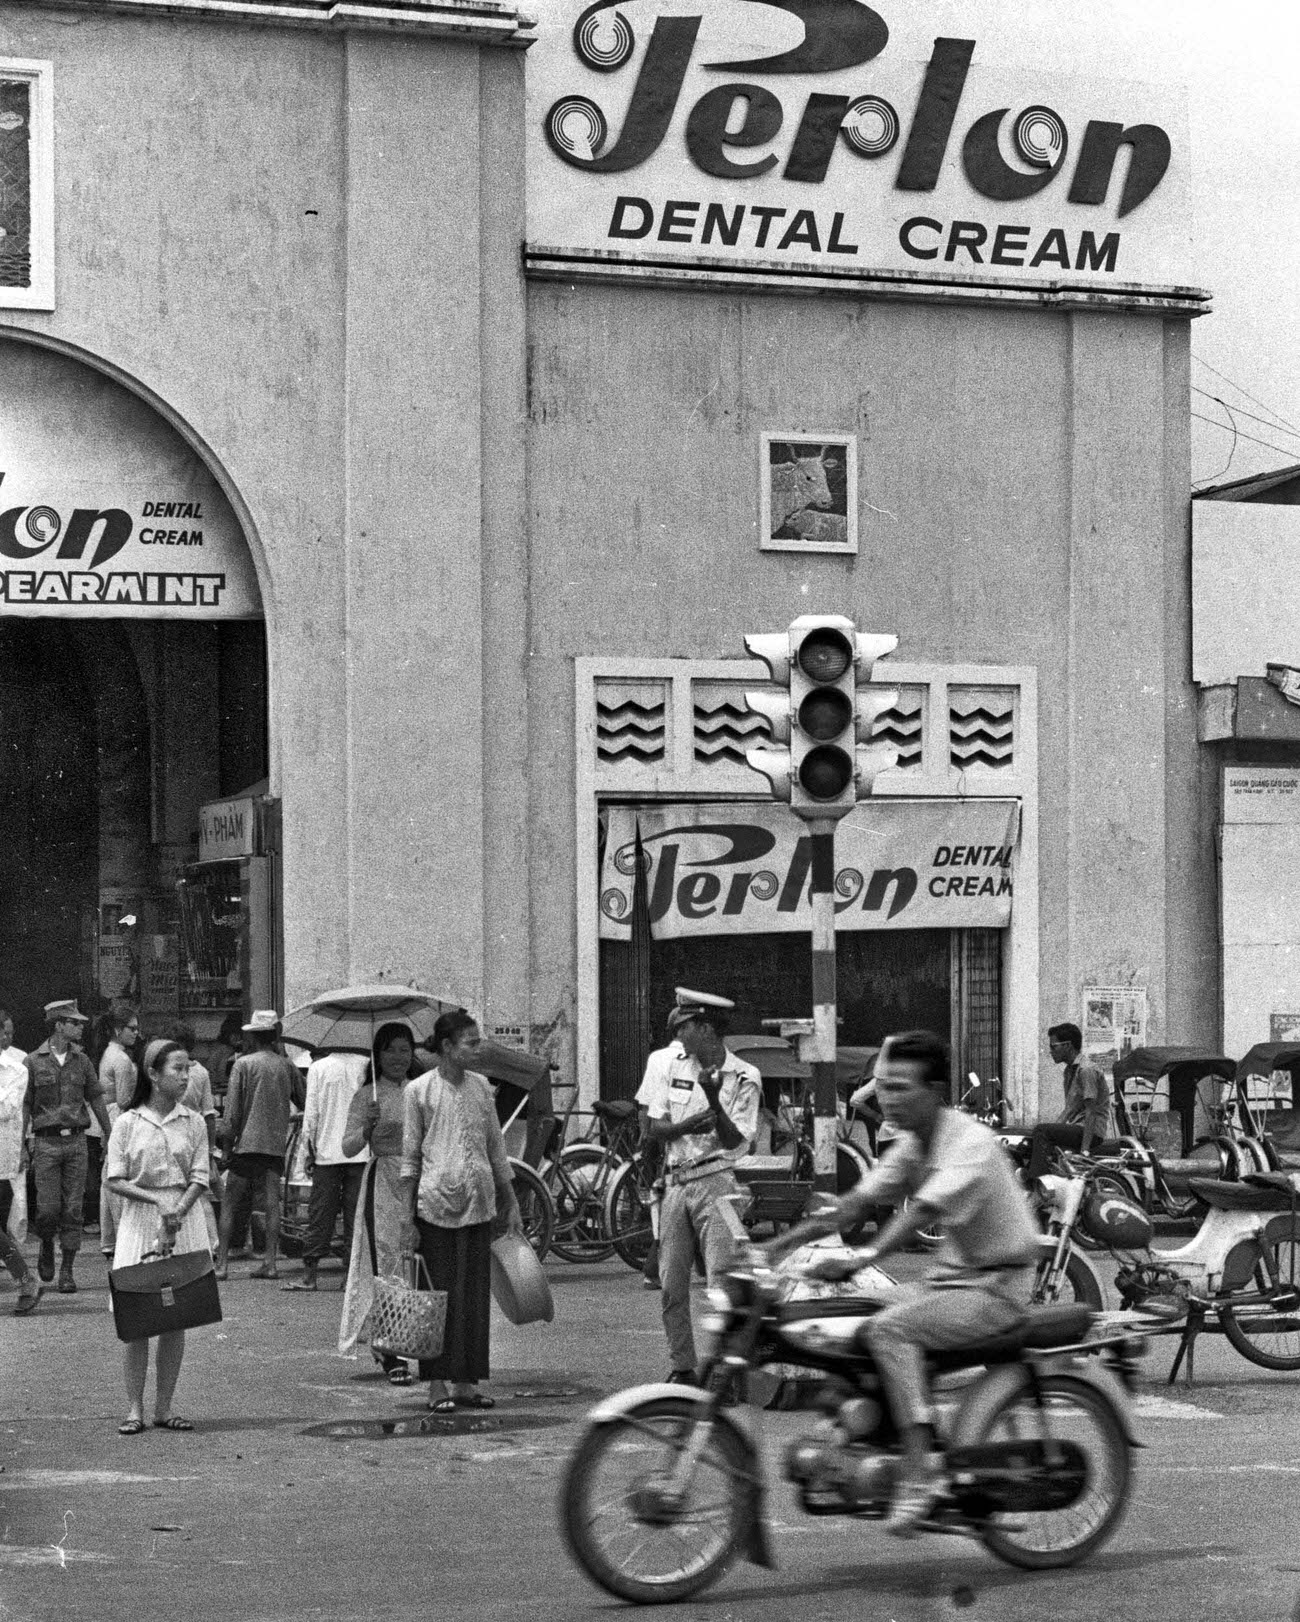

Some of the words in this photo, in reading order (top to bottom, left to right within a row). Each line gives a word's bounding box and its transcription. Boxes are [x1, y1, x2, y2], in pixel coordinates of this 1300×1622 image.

[545, 0, 1171, 219] Perlon
[607, 196, 859, 254] DENTAL
[898, 216, 1121, 273] CREAM
[0, 472, 133, 570] on
[141, 501, 203, 518] DENTAL
[139, 528, 203, 546] CREAM
[0, 571, 226, 606] EARMINT
[932, 845, 1012, 868] DENTAL
